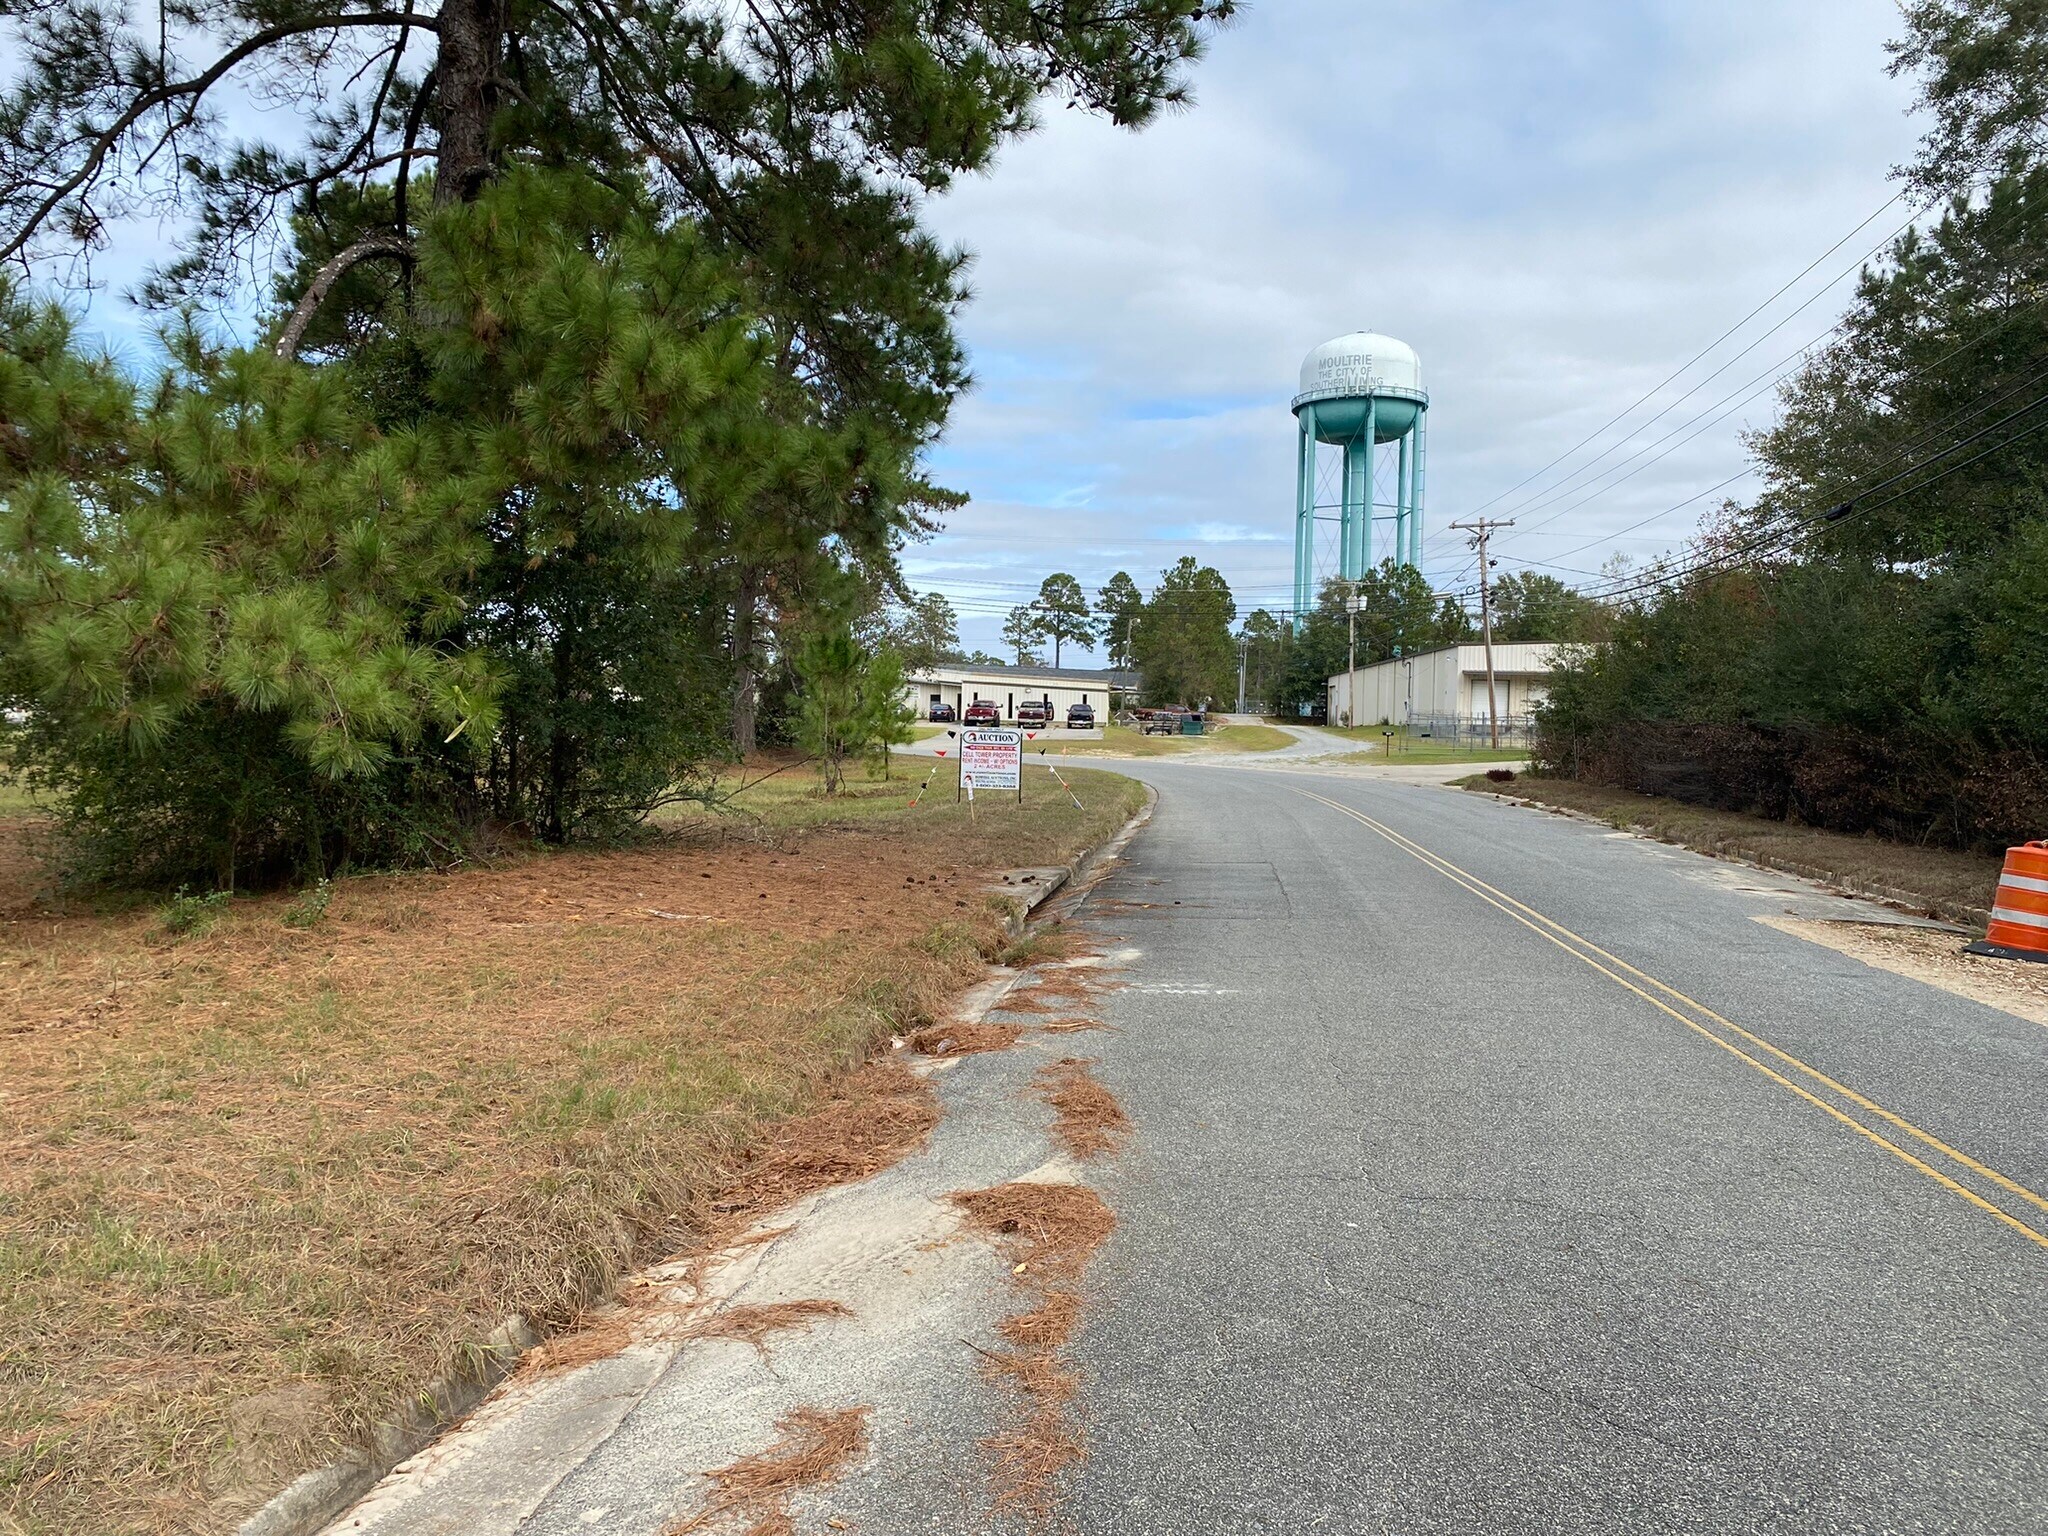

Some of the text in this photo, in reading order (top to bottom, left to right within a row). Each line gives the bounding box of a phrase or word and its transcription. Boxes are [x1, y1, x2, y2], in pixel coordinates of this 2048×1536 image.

[1318, 354, 1372, 370] MOULTRIE
[1318, 366, 1372, 379] THE CITY OF
[978, 734, 1013, 742] AUCTION
